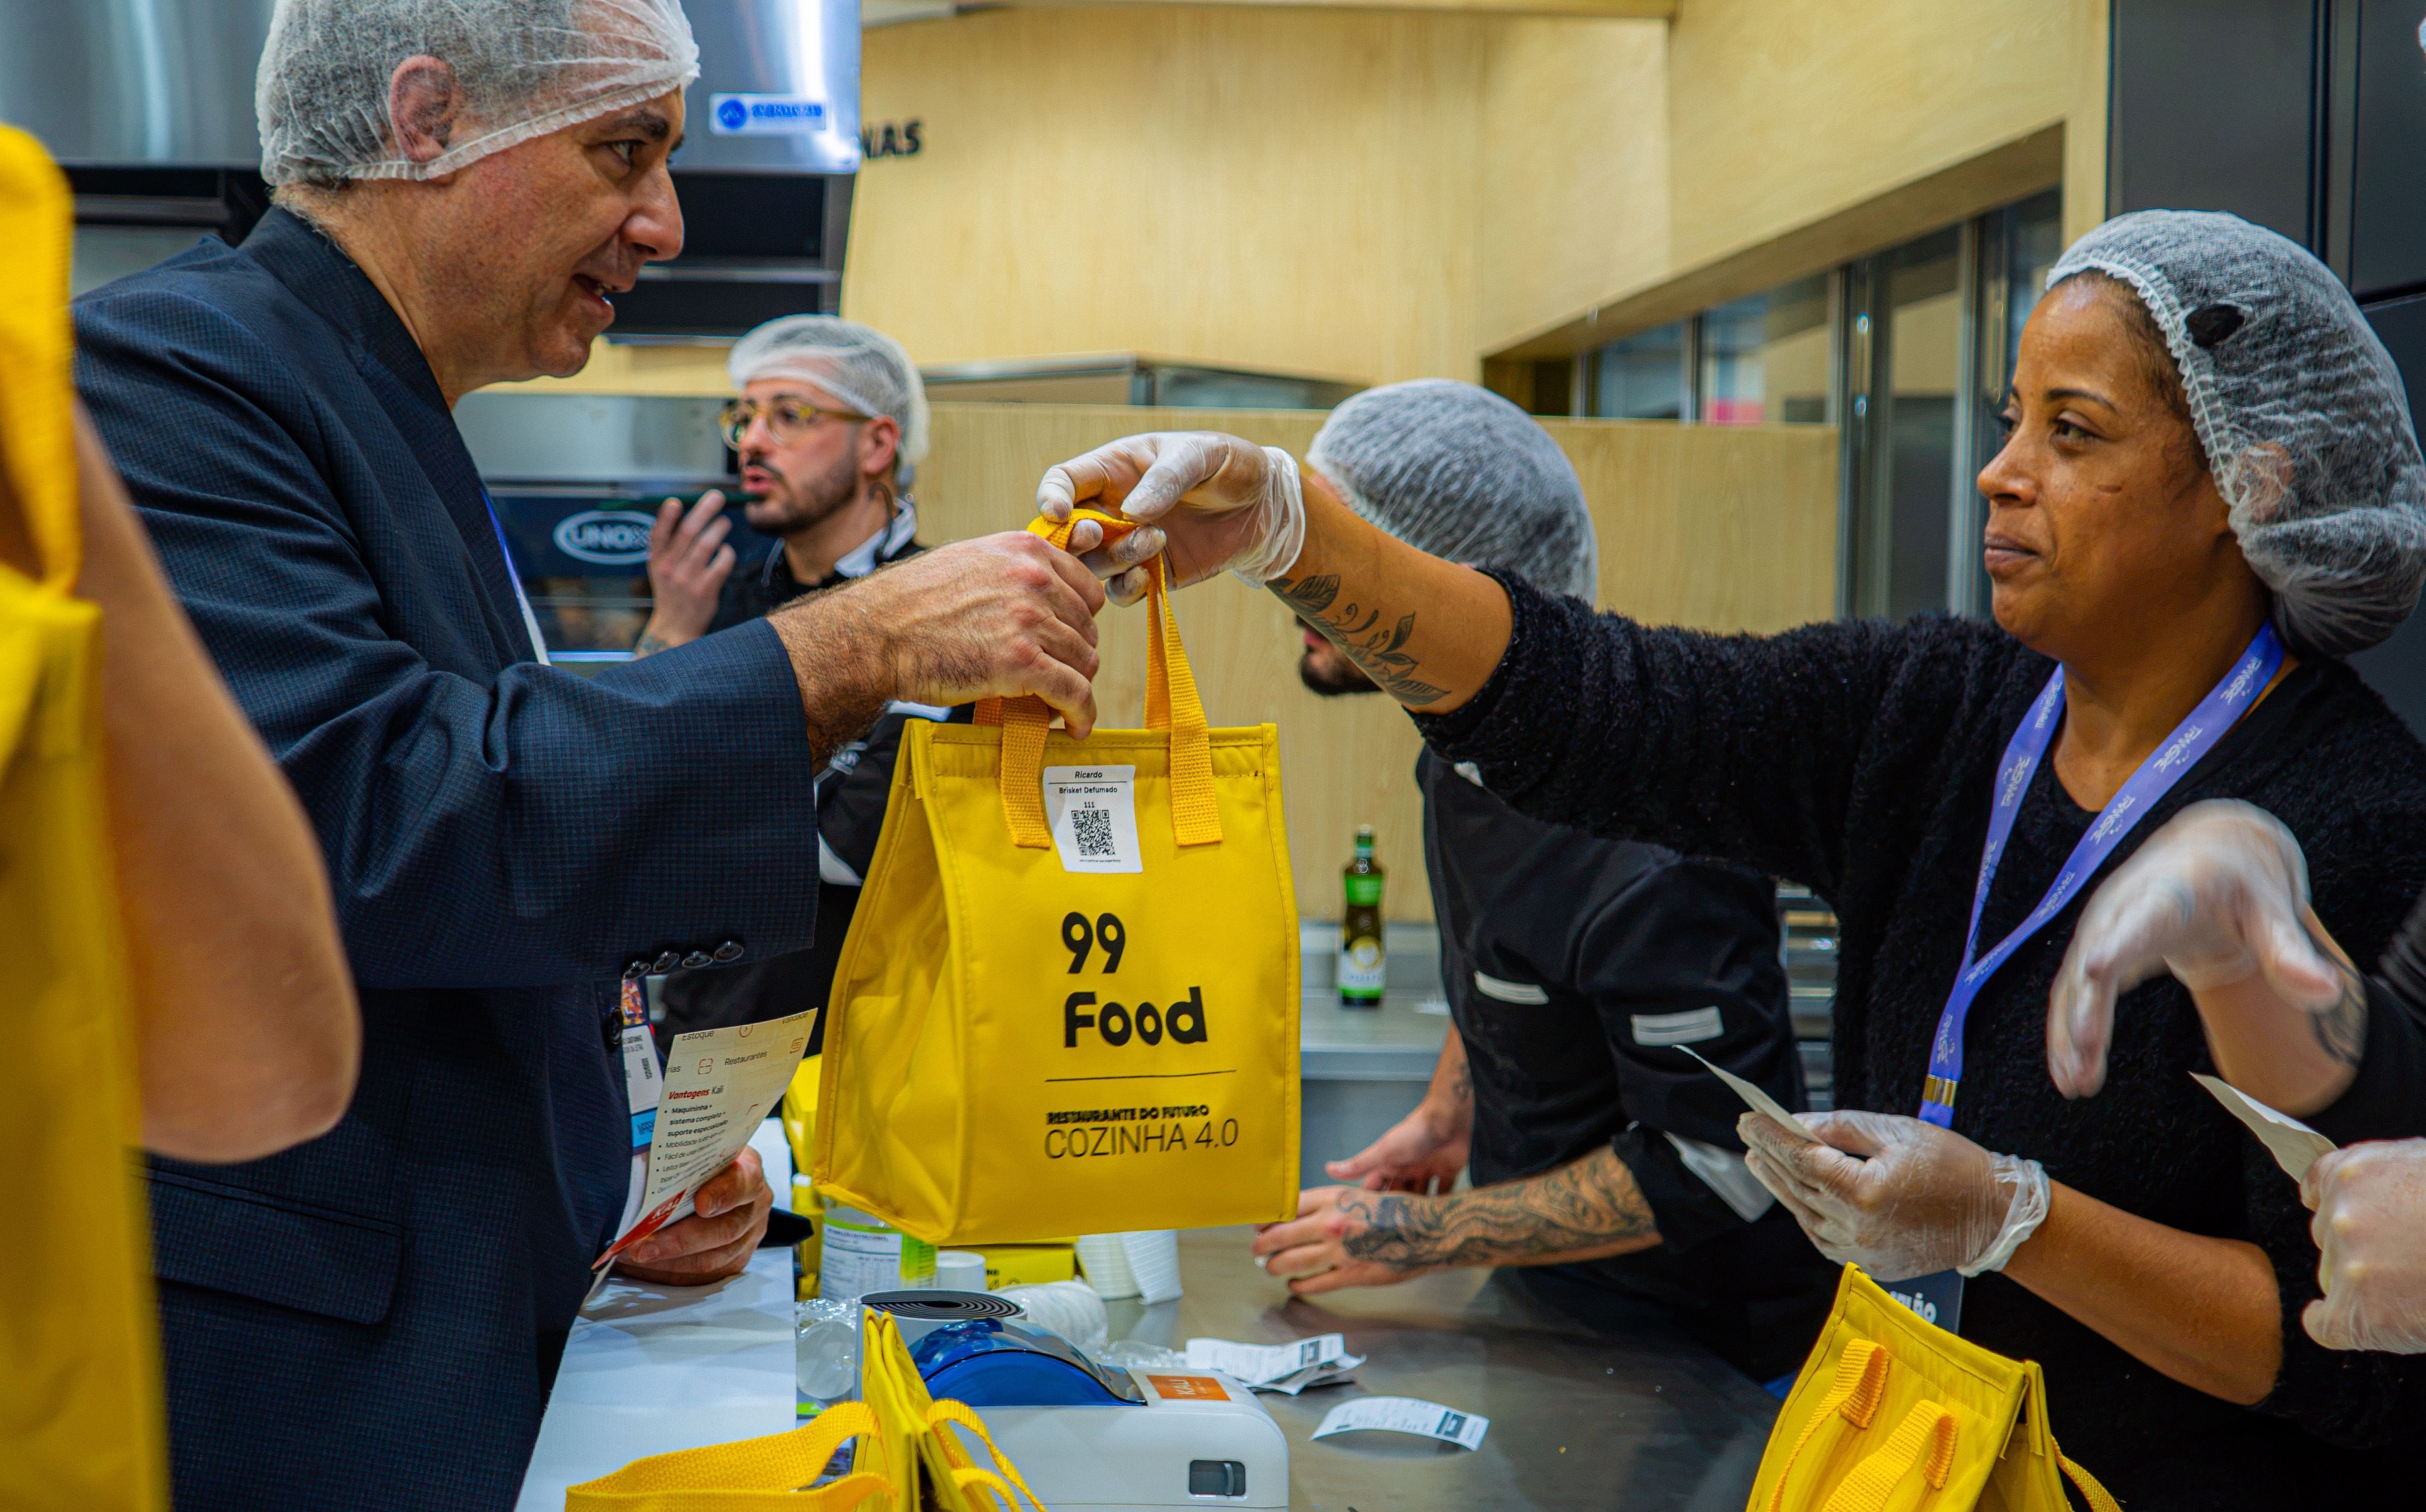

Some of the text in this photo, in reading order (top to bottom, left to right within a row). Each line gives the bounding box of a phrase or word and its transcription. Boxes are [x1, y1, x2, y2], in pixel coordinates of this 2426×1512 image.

[1075, 771, 1102, 779] Ricardo
[1061, 911, 1126, 974] 99
[1064, 986, 1208, 1048] Food
[724, 1051, 768, 1065] Restaurantes
[668, 1088, 710, 1100] Vantagens
[672, 1105, 708, 1114] Maquininha
[1046, 1105, 1209, 1125] RESTAURANTE DO FUTURO
[670, 1117, 695, 1125] sistema
[668, 1128, 692, 1137] suporte
[1044, 1118, 1238, 1159] COZINHA 4.0
